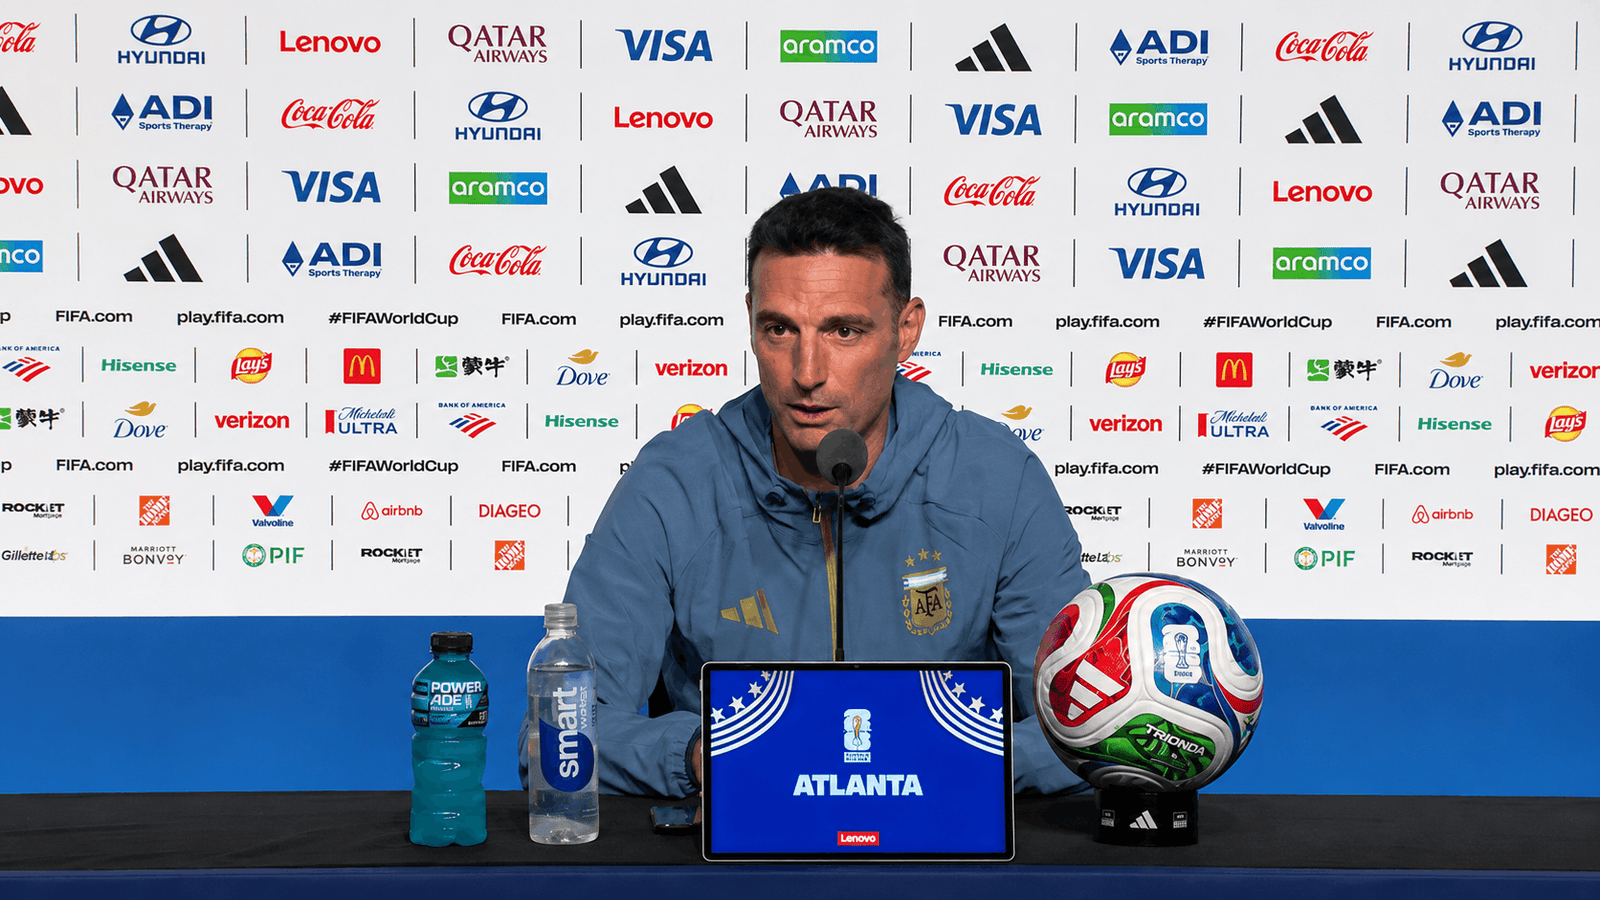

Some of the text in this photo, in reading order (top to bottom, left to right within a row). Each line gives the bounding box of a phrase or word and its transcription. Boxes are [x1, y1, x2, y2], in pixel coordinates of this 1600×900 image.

[280, 31, 381, 54] Lenovo
[448, 25, 547, 52] QATAR
[615, 29, 713, 62] VISA
[783, 38, 874, 54] aramco
[1137, 30, 1208, 54] ADI
[1276, 31, 1374, 62] Coca-Cola
[117, 51, 205, 65] HYUNDAI
[474, 51, 548, 64] AIRWAYS
[1136, 57, 1208, 67] Sports Therapy
[1449, 57, 1535, 71] HYUNDAI
[139, 95, 212, 119] ADI
[281, 99, 380, 129] Coca-Cola
[780, 100, 877, 127] QATAR
[1469, 101, 1541, 125] ADI
[615, 106, 713, 129] Lenovo
[945, 104, 1042, 136] VISA
[1112, 112, 1204, 128] aramco
[138, 122, 212, 132] Sports Therapy
[455, 127, 541, 141] HYUNDAI
[805, 125, 877, 138] AIRWAYS
[1468, 128, 1541, 138] Sports Therapy
[0, 177, 43, 195] ovo
[113, 166, 212, 193] QATAR
[282, 171, 381, 203] VISA
[1441, 172, 1539, 199] QATAR
[452, 180, 545, 197] aramco
[944, 176, 1041, 207] Coca-Cola
[1273, 181, 1372, 203] Lenovo
[139, 191, 213, 205] AIRWAYS
[1465, 196, 1540, 210] AIRWAYS
[1114, 203, 1200, 216] HYUNDAI
[309, 243, 381, 267] ADI
[449, 245, 547, 276] Coca-Cola
[944, 245, 1040, 272] QATAR
[1109, 248, 1205, 280] VISA
[1276, 256, 1369, 272] aramco
[308, 269, 381, 279] Sports Therapy
[621, 273, 706, 286] HYUNDAI
[968, 269, 1040, 282] AIRWAYS
[55, 310, 133, 322] FIFA.com
[177, 311, 285, 325] play.fifa.com
[328, 312, 459, 327] #FIFAWorldCup
[501, 313, 577, 326] FIFA.com
[620, 314, 724, 329] play.fifa.com
[938, 315, 1013, 328] FIFA.com
[1055, 315, 1160, 330] play.fifa.com
[1203, 315, 1333, 330] #FIFAWorldCup
[1376, 316, 1452, 329] FIFA.com
[1495, 316, 1600, 331] play.fifa.com
[101, 359, 177, 373] Hisense
[235, 357, 269, 375] Lay's
[462, 355, 506, 379] 蒙牛
[655, 359, 728, 376] verizon
[981, 363, 1054, 376] Hisense
[1110, 360, 1144, 378] Lay's
[1334, 359, 1378, 381] 蒙牛
[556, 366, 609, 386] Dove
[1429, 369, 1482, 389] Dove
[16, 407, 61, 430] 蒙牛
[214, 411, 290, 429] verizon
[545, 415, 619, 428] Hisense
[1089, 415, 1163, 432] verizon
[1417, 417, 1493, 431] Hisense
[1549, 414, 1583, 433] Lay's
[114, 418, 167, 439] Dove
[338, 422, 398, 435] ULTRA
[1012, 427, 1042, 442] ove
[1210, 425, 1270, 438] ULTRA
[56, 459, 133, 472] FIFA.com
[178, 459, 285, 474] play.fifa.com
[328, 459, 459, 475] #FIFAWorldCup
[501, 460, 577, 473] FIFA.com
[1054, 462, 1159, 477] play.fifa.com
[1201, 463, 1331, 477] #FIFAWorldCup
[1374, 464, 1450, 476] FIFA.com
[1494, 464, 1600, 478] play.fifa.com
[381, 504, 423, 516] airbnb
[478, 504, 541, 518] DIAGEO
[1432, 509, 1474, 521] airbnb
[1530, 508, 1593, 522] DIAGEO
[252, 518, 294, 528] Valvoline
[1303, 522, 1345, 531] Valvoline
[270, 547, 305, 564] PIF
[1321, 550, 1355, 567] PIF
[915, 587, 943, 617] AFA
[431, 681, 482, 694] POWER
[430, 694, 462, 706] ADE
[553, 686, 579, 778] smart
[1145, 723, 1206, 757] TRIONDA
[793, 774, 924, 796] ATLANTA
[840, 833, 876, 844] Lenovo
